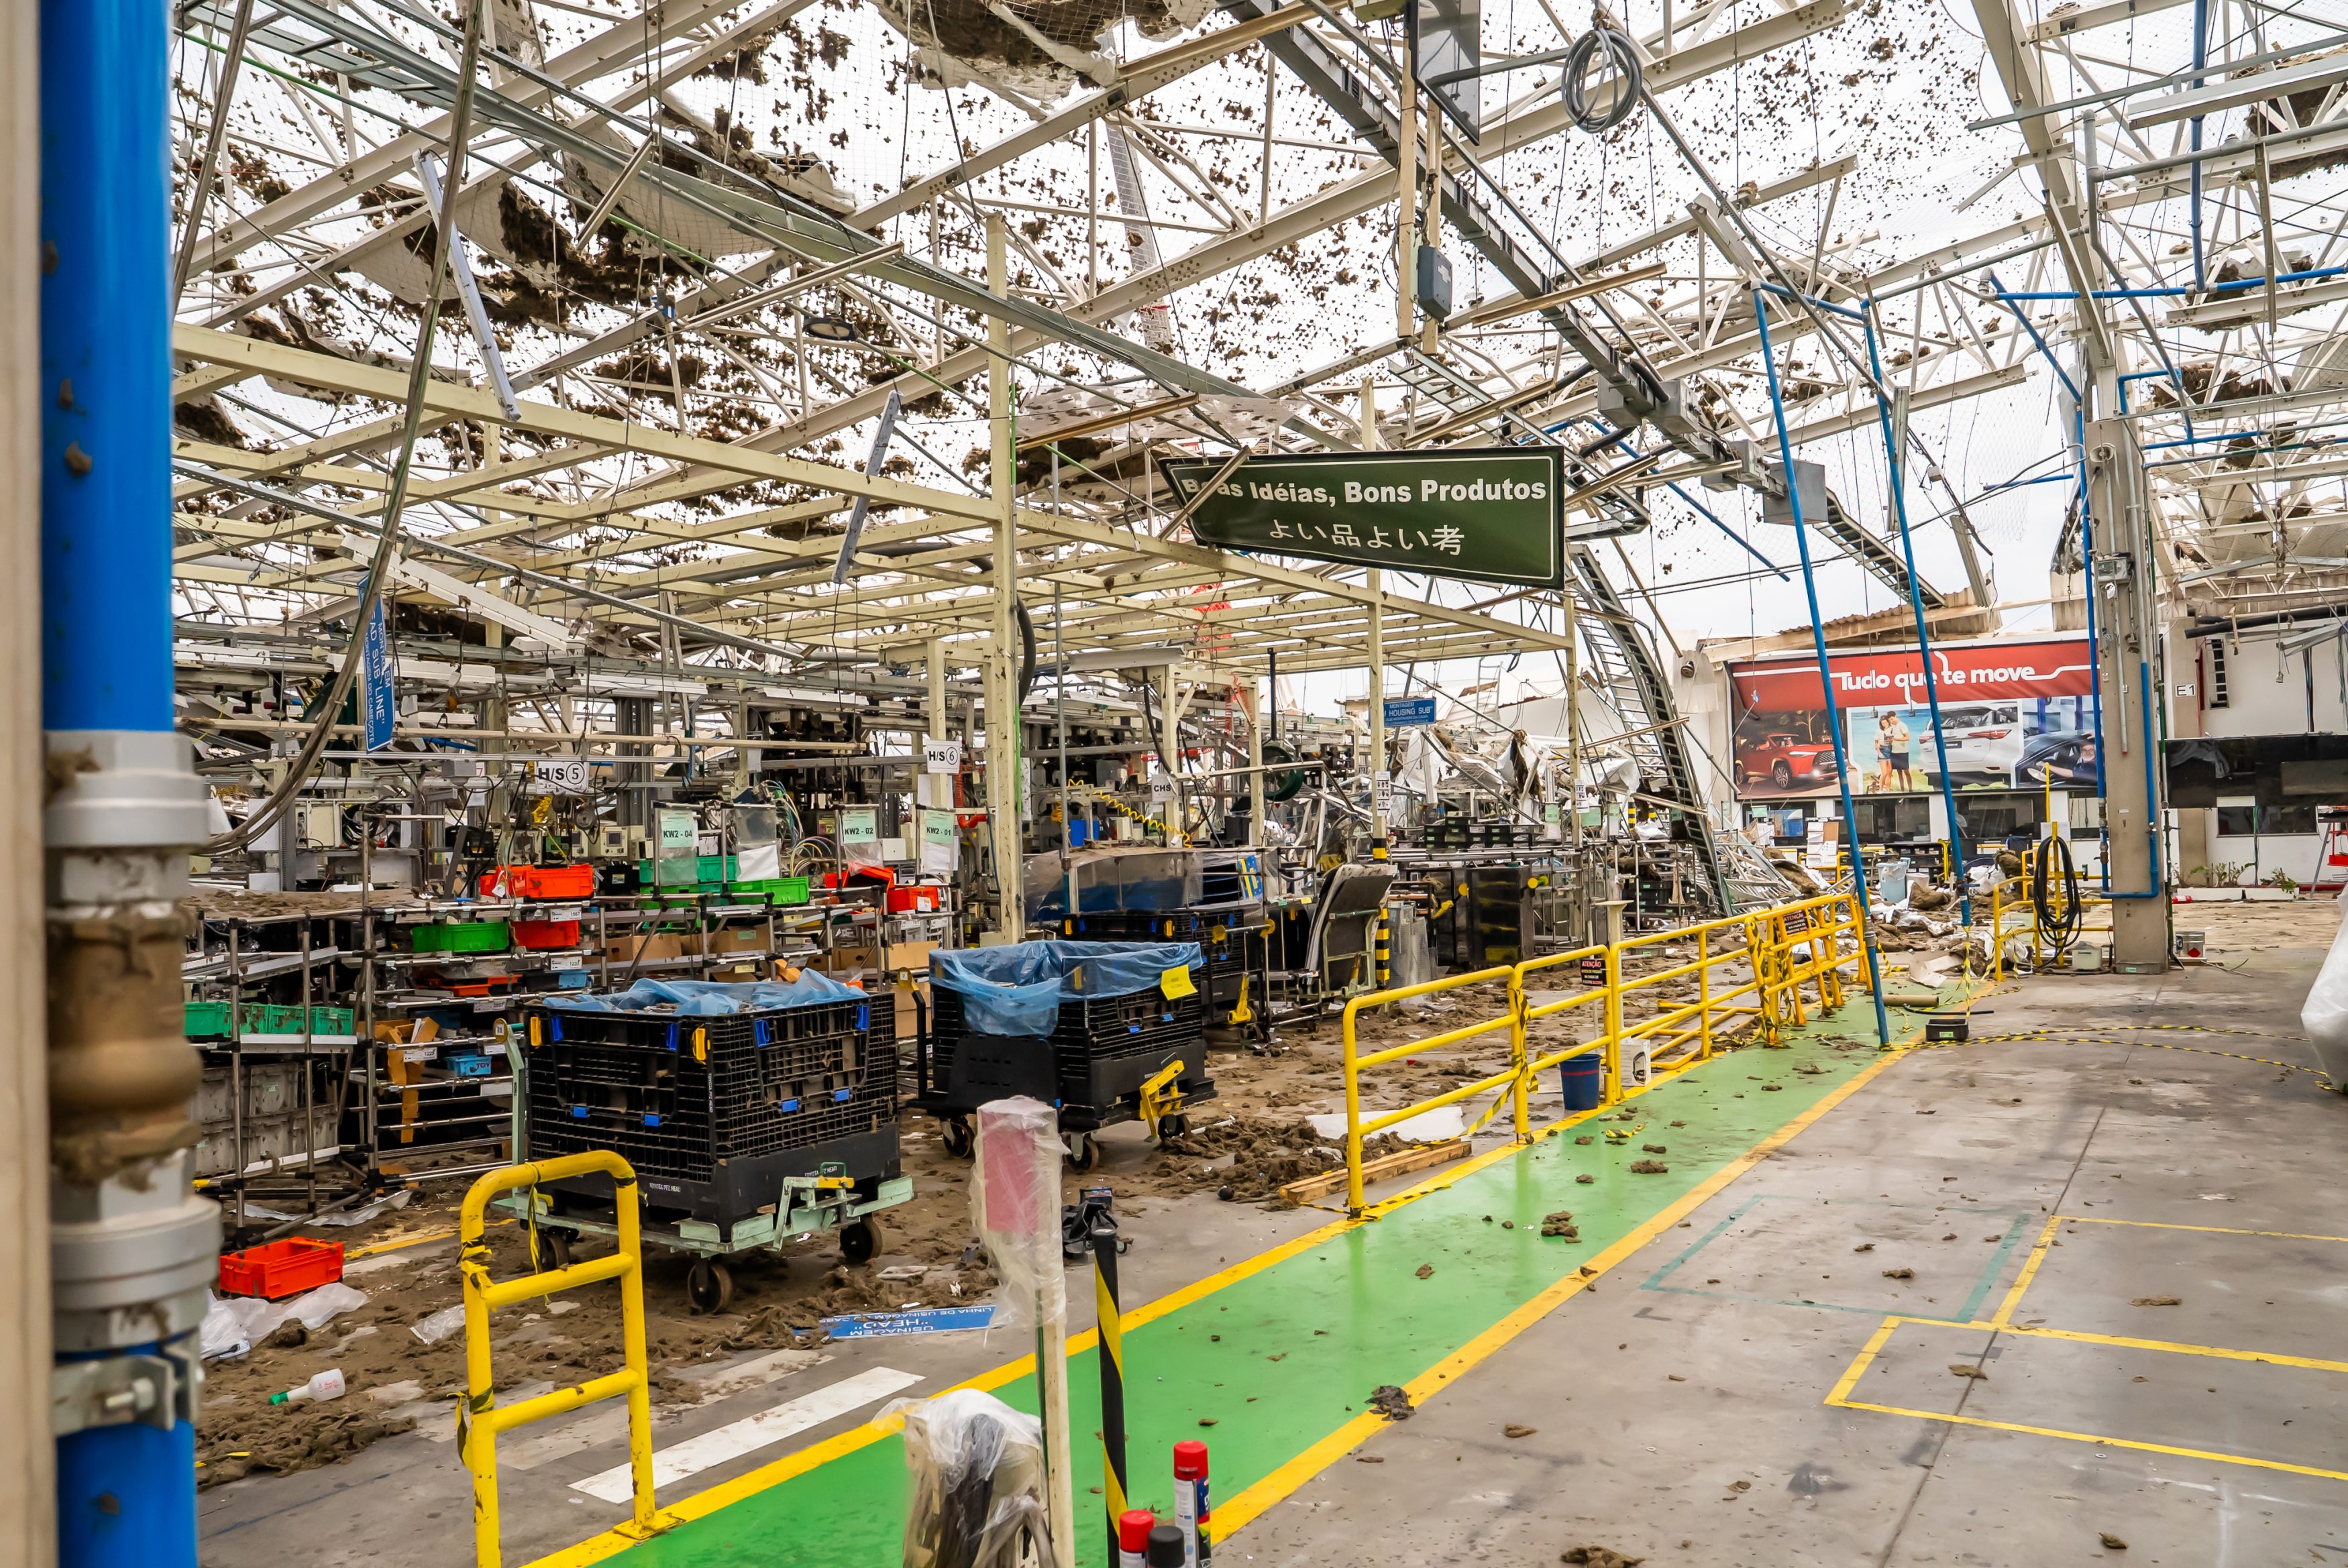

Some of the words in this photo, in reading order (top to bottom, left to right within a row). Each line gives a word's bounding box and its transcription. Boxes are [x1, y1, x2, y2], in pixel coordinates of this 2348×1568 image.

[1249, 481, 1336, 508] Idéias,
[1344, 482, 1411, 502] Bons
[1421, 478, 1546, 502] Produtos
[1269, 518, 1465, 556] よい品よい考
[372, 649, 380, 679] SUB
[1837, 669, 1890, 691] Tudo
[1941, 659, 1966, 685] te
[1970, 666, 2035, 683] move
[368, 683, 373, 695] DO
[2176, 685, 2194, 696] E1
[1389, 708, 1416, 716] HOUSING
[928, 750, 945, 761] H/S
[538, 767, 564, 781] H/S
[684, 830, 692, 838] 04
[874, 1311, 937, 1319] USINAGEM
[849, 1326, 934, 1336] USINAGEM
